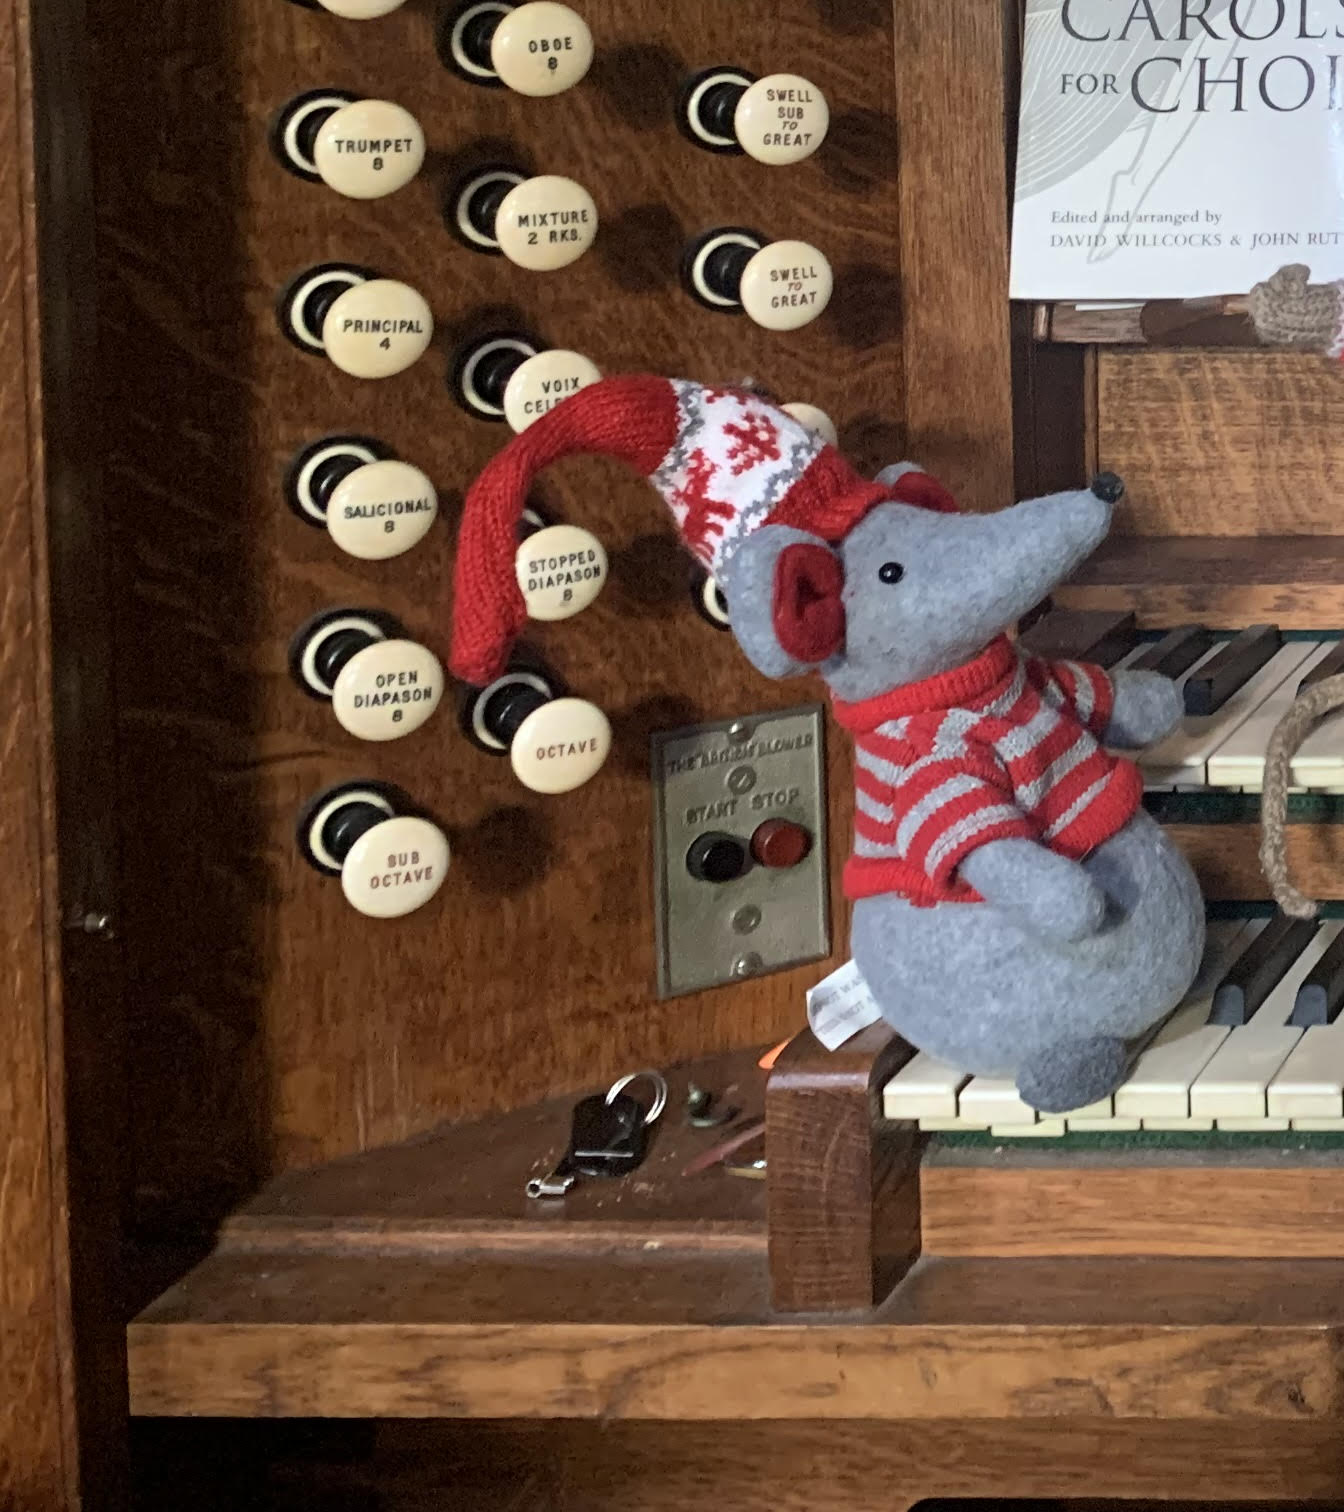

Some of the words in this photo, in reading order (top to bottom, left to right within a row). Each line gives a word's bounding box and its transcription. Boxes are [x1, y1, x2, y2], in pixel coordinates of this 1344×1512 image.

[528, 36, 573, 54] OBOE
[547, 56, 558, 71] 8
[1060, 72, 1120, 96] FOR
[766, 88, 813, 103] SWELL
[777, 106, 804, 120] SUB
[782, 121, 798, 131] TO
[334, 139, 413, 154] TRUMPET
[762, 133, 813, 147] GREAT
[372, 157, 384, 172] 8
[517, 209, 589, 229] MIXTURE
[1050, 210, 1098, 225] Edited
[1103, 210, 1130, 224] and
[1135, 210, 1200, 228] arranged
[1205, 209, 1223, 226] by
[527, 231, 539, 246] 2
[1049, 233, 1107, 249] DAVID
[1116, 233, 1222, 248] WILLCOCKS
[1229, 235, 1242, 248] &
[1249, 232, 1299, 251] JOHN
[769, 265, 818, 282] SWELL
[787, 282, 803, 292] TO
[770, 291, 817, 309] GREAT
[342, 319, 423, 334] PRINCIPAL
[379, 337, 391, 351] 4
[541, 376, 580, 394] VOIX
[343, 497, 432, 520] SALICIONAL
[384, 520, 395, 534] 8
[528, 548, 597, 574] STOPPED
[528, 566, 601, 592] DIAPASON
[562, 588, 574, 603] 8
[375, 670, 418, 688] OPEN
[353, 686, 433, 709] DIAPASON
[391, 709, 404, 723] 8
[535, 737, 599, 761] OCTAVE
[686, 799, 738, 825] START
[750, 787, 800, 810] STOP
[387, 851, 420, 869] SUB
[369, 866, 434, 890] OCTAVE
